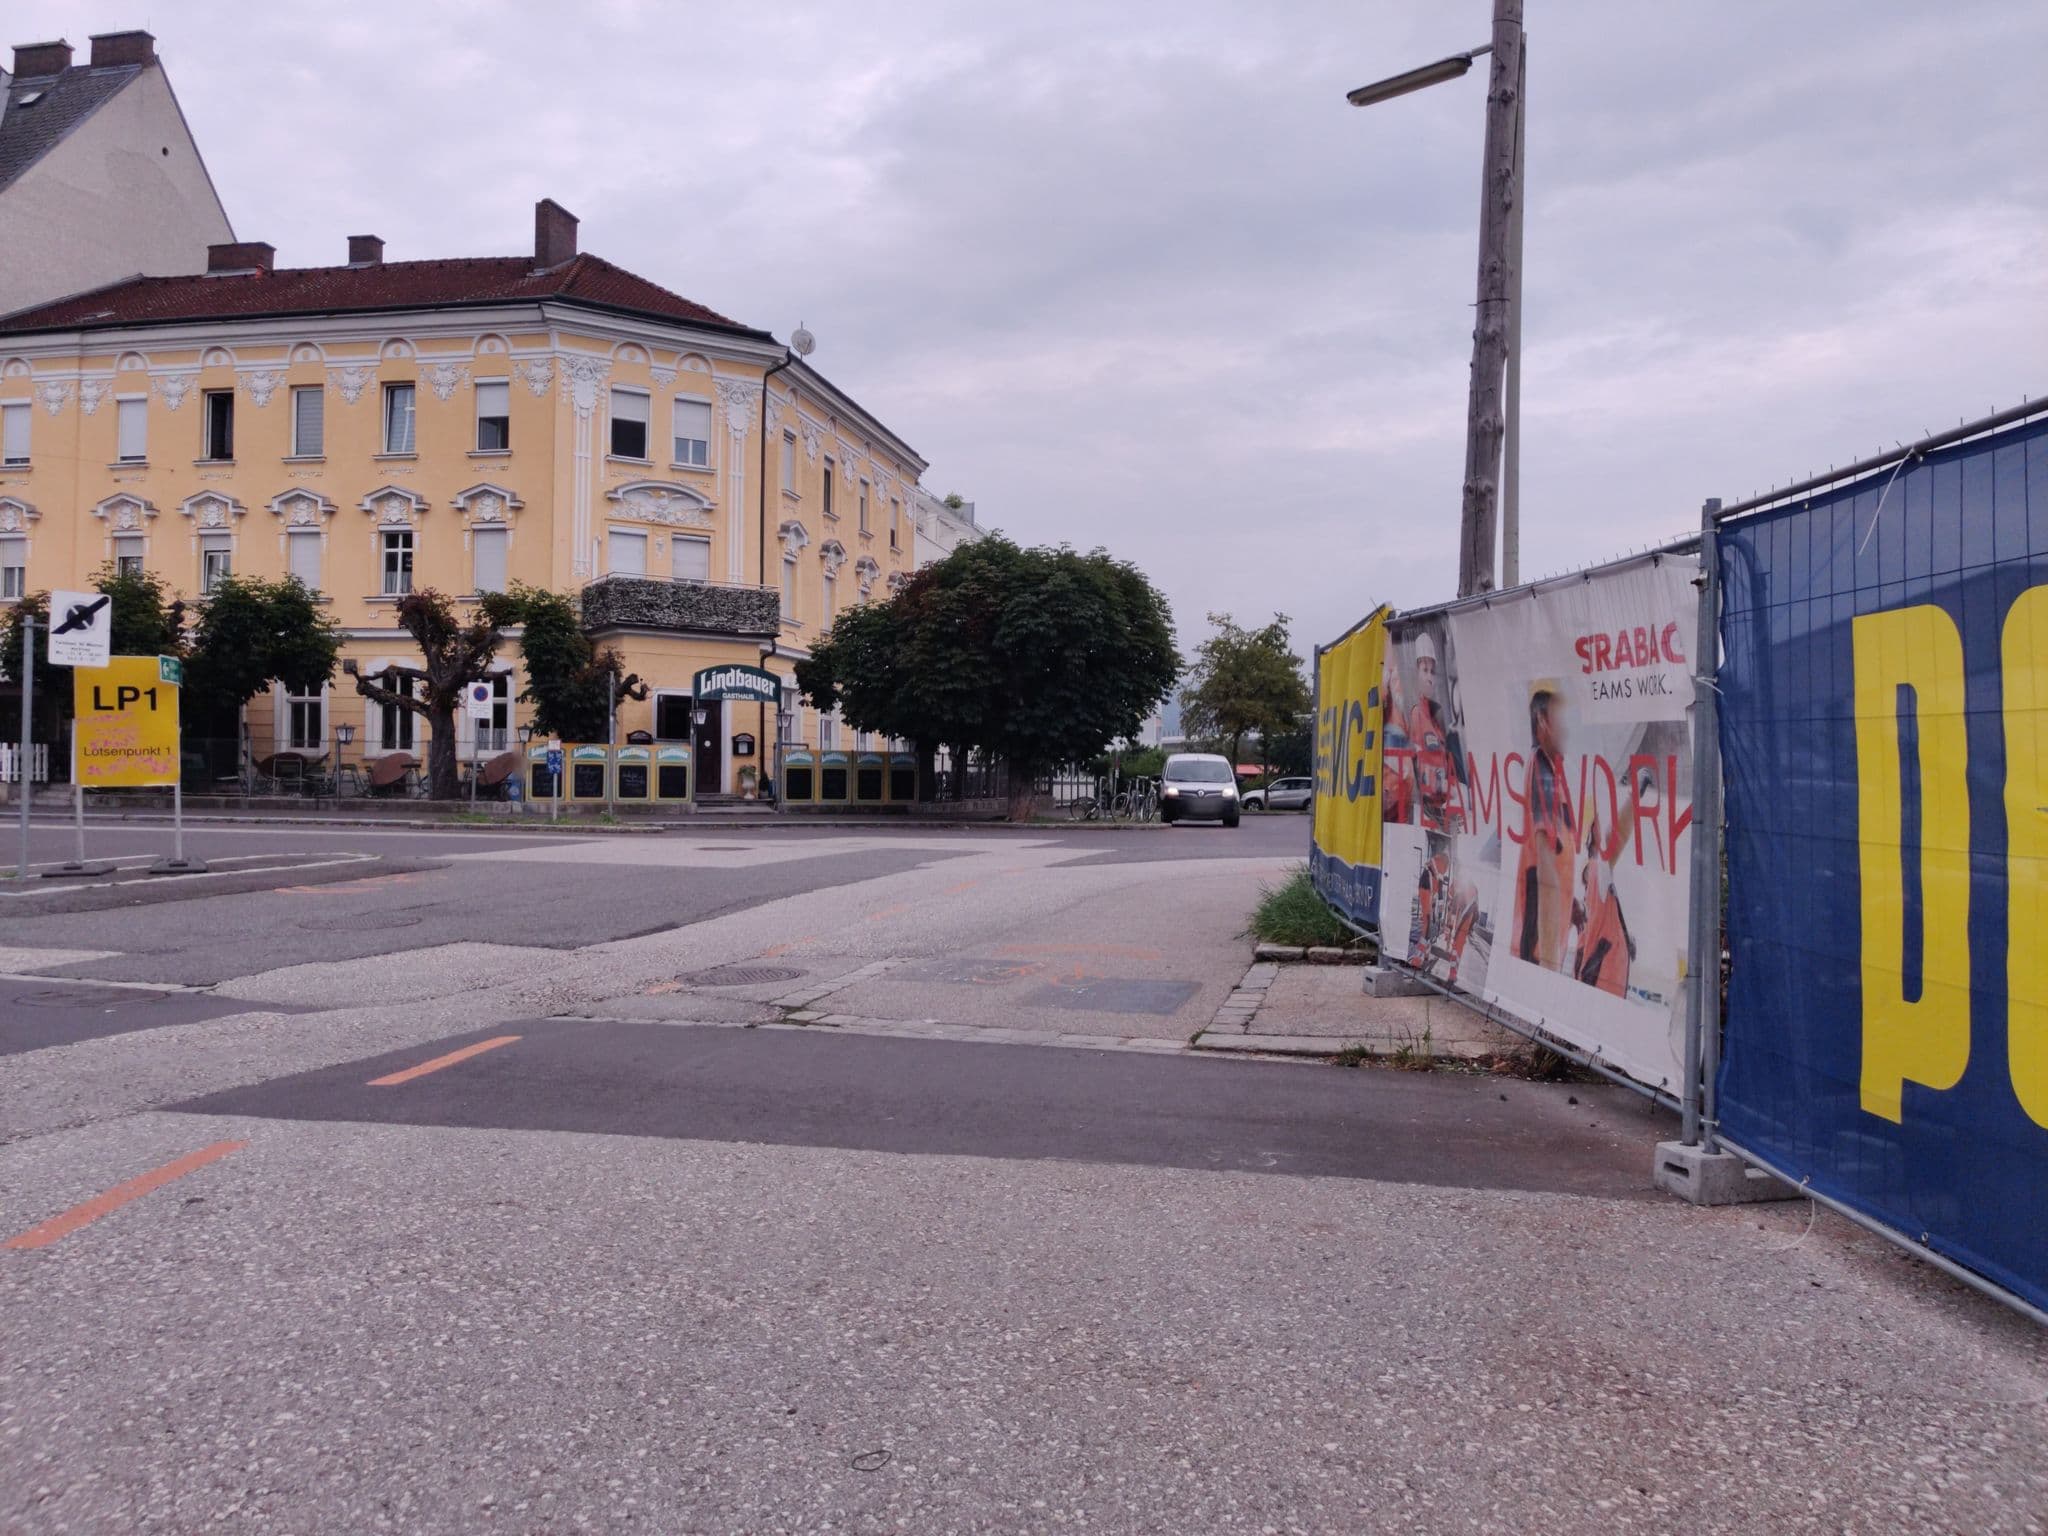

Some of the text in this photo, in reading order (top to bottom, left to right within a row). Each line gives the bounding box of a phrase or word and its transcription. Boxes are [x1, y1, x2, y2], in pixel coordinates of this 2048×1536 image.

[700, 667, 776, 696] Lindbauer
[1592, 678, 1632, 701] EAMS
[94, 686, 157, 711] LP1
[83, 746, 171, 758] Lotsenpunkt 1
